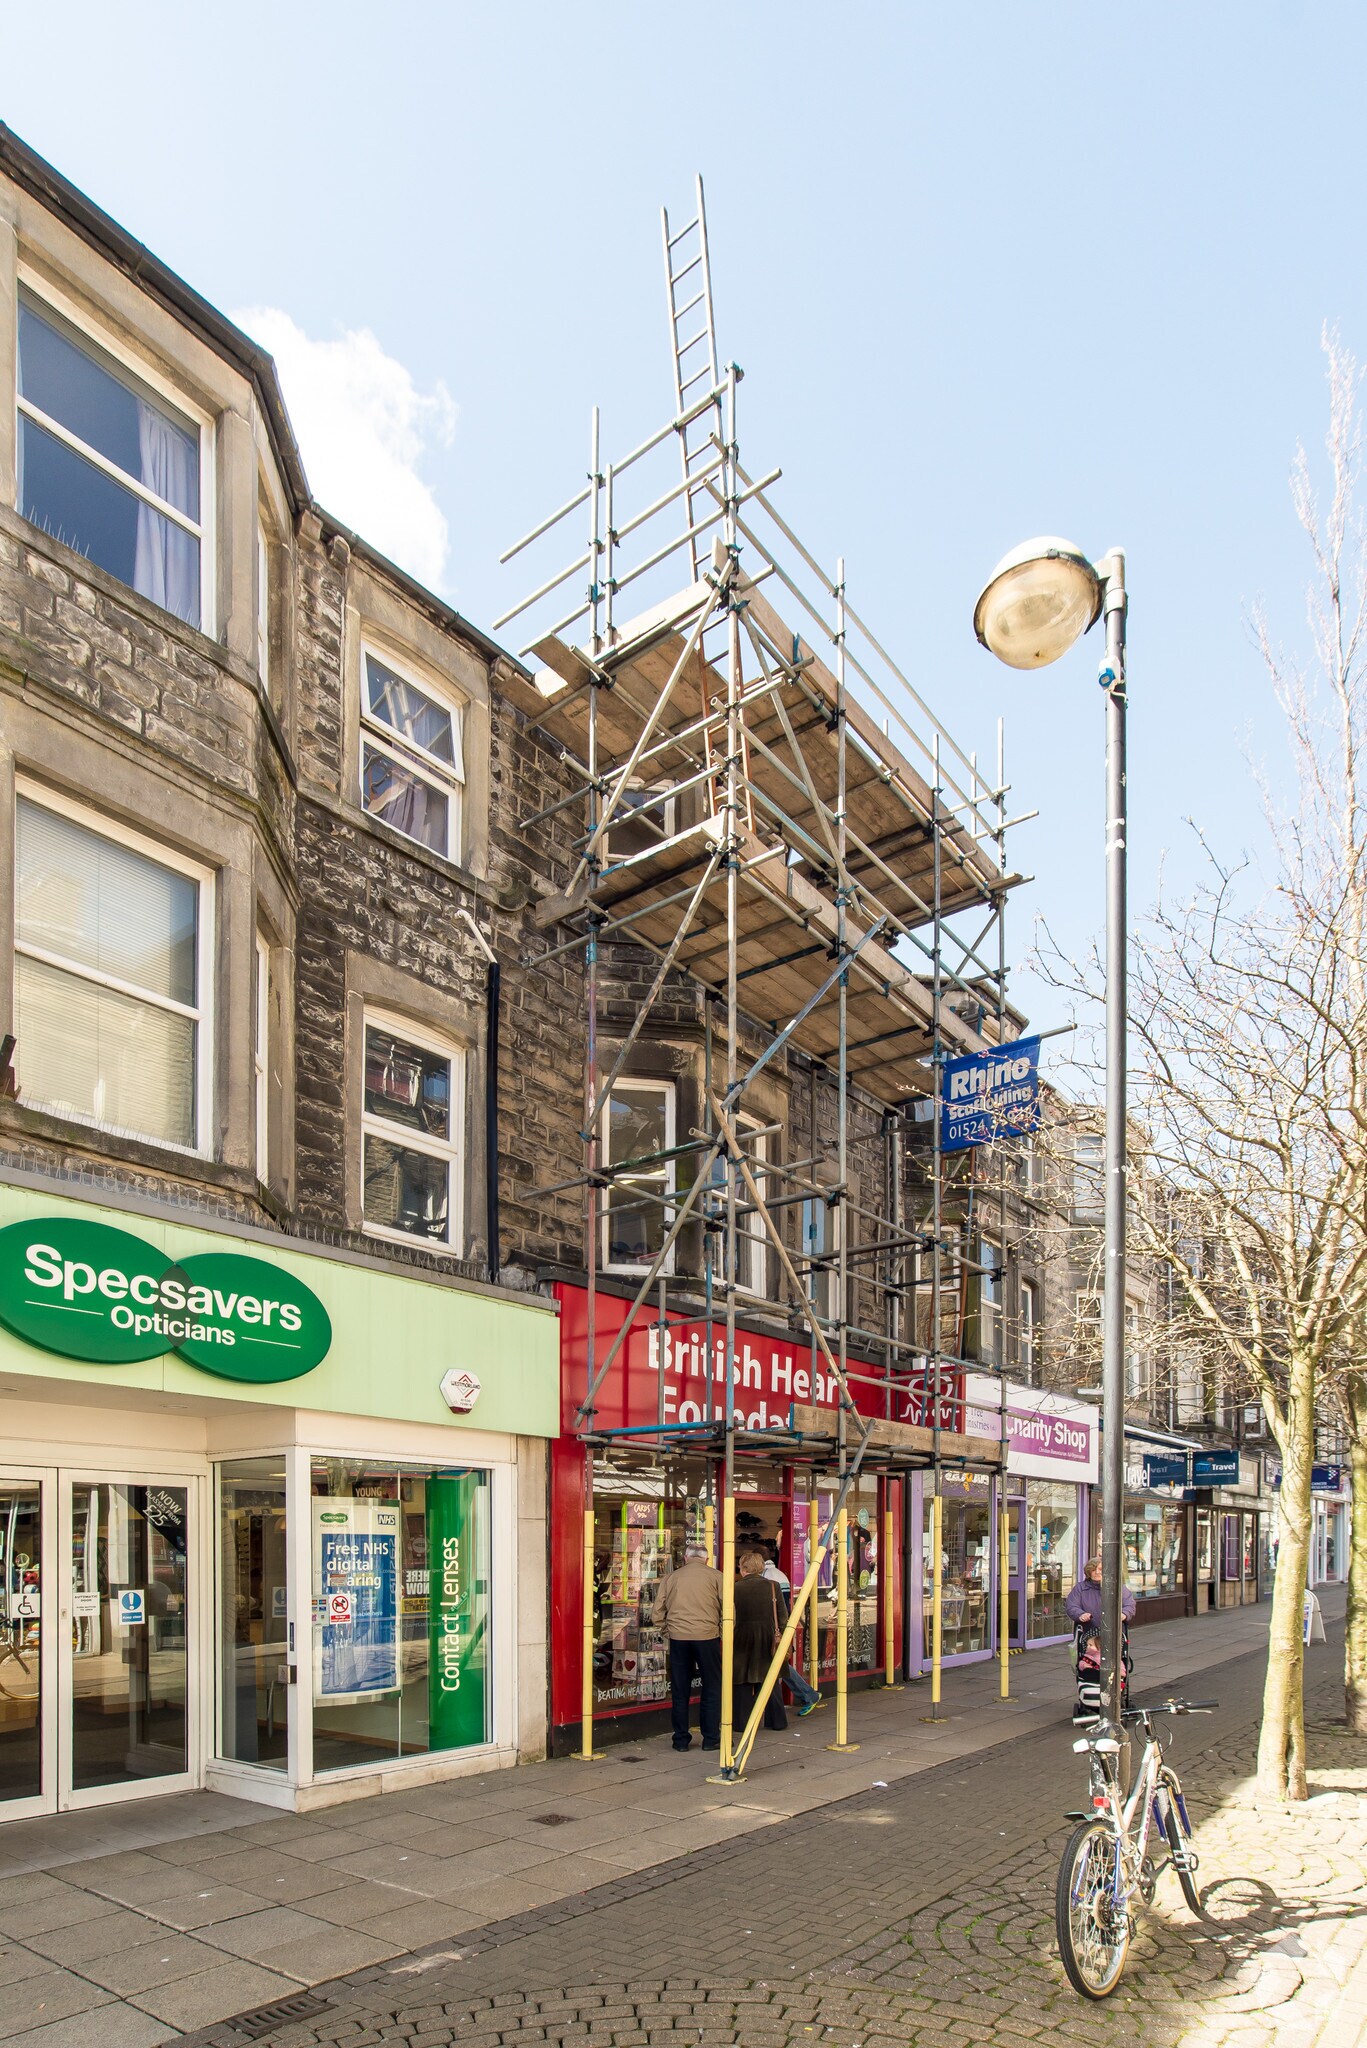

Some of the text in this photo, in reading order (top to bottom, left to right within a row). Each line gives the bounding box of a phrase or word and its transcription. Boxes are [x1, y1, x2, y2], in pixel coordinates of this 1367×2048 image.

[951, 1057, 1031, 1100] Rhino
[949, 1119, 985, 1140] 01524
[24, 1244, 302, 1331] Specsavers
[110, 1305, 236, 1346] Opticians
[648, 1328, 848, 1404] British Hear
[1006, 1415, 1087, 1453] Charity Shop
[1123, 1462, 1150, 1488] Travel
[1212, 1462, 1236, 1471] Travel
[157, 1490, 182, 1513] NOW
[355, 1487, 382, 1497] YOUNG
[142, 1504, 168, 1526] £25
[145, 1490, 181, 1525] GLASSES FROM
[633, 1504, 651, 1513] CARDS
[378, 1515, 395, 1524] NHS
[327, 1542, 389, 1555] Free NHS
[327, 1557, 373, 1574] digital
[440, 1537, 459, 1607] Lenses
[327, 1573, 381, 1589] aring
[441, 1613, 460, 1692] Contact
[597, 1687, 626, 1703] BEATING
